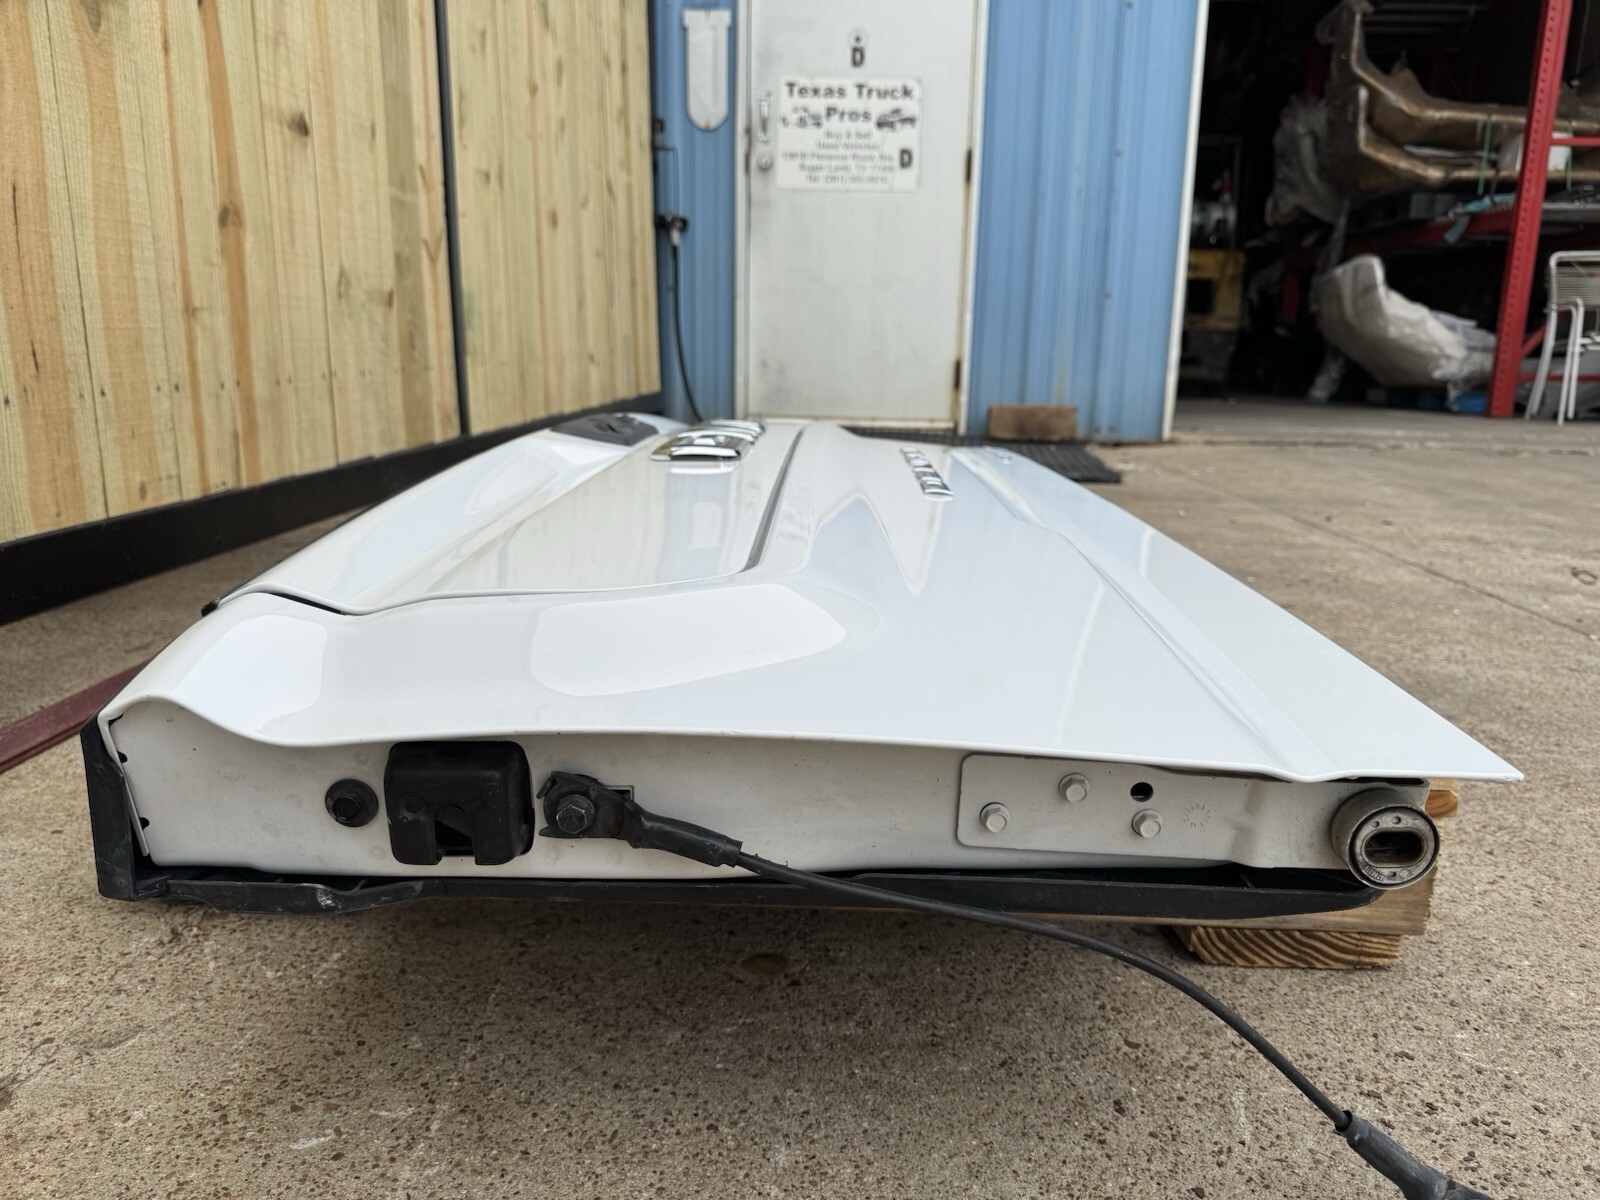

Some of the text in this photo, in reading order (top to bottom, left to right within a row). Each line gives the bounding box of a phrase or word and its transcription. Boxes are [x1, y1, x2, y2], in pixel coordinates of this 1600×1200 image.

[851, 47, 864, 68] D
[786, 82, 913, 99] Texas Truck
[826, 107, 871, 122] Pros
[899, 148, 912, 168] D
